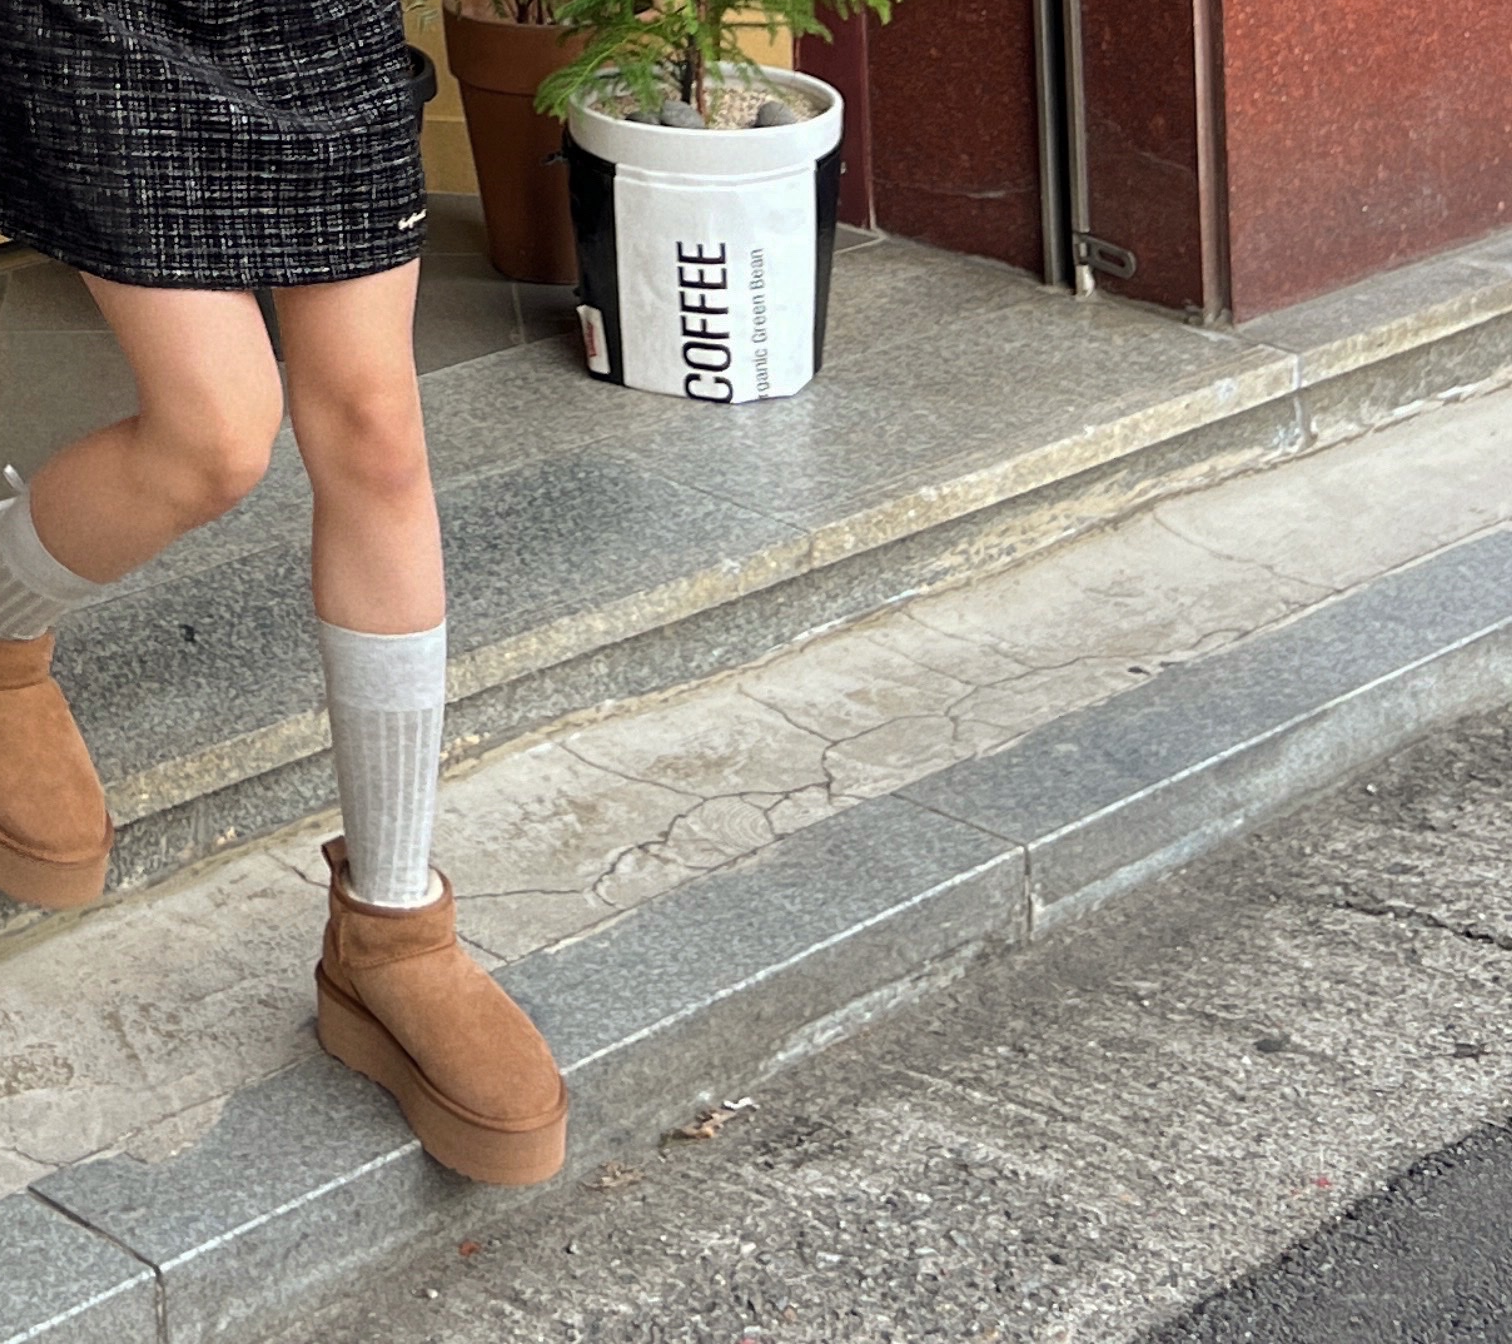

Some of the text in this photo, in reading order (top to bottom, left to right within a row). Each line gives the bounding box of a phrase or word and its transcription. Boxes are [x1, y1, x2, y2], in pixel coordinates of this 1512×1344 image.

[749, 247, 766, 290] Bean
[676, 241, 734, 404] COFFEE
[750, 293, 768, 344] Green
